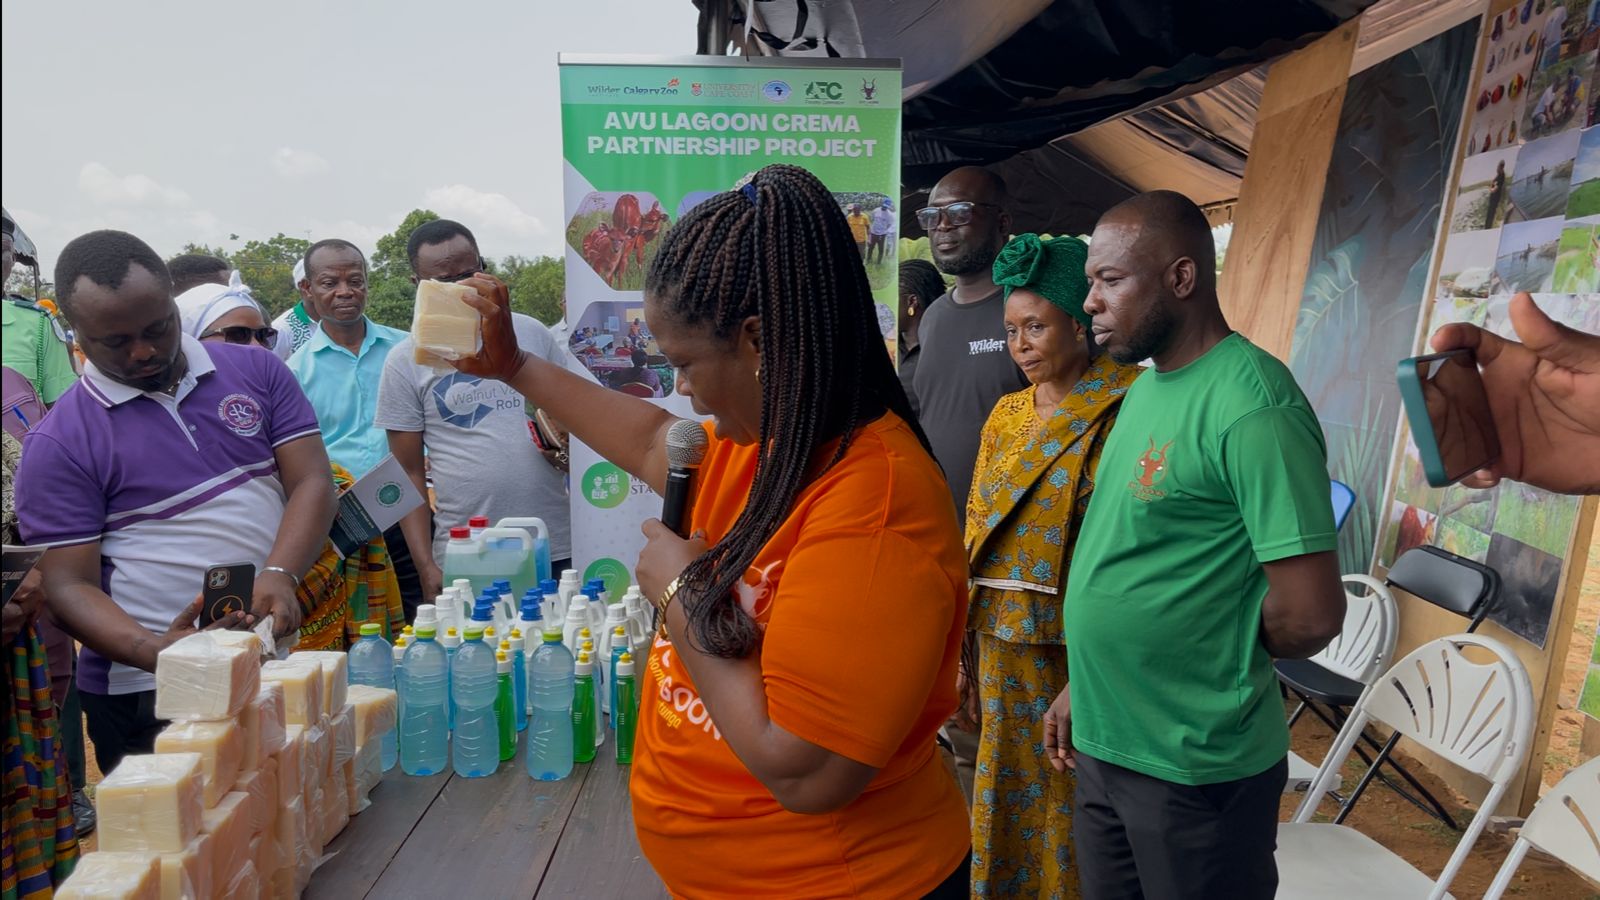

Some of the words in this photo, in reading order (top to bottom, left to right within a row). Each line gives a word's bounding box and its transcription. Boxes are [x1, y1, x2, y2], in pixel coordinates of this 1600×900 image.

[604, 111, 657, 131] AVU
[661, 111, 768, 132] LAGOON
[772, 113, 860, 133] CREMA
[587, 135, 760, 156] PARTNERSHIP
[765, 138, 877, 158] PROJECT
[969, 338, 1006, 352] Wilder
[452, 387, 497, 406] Walnut
